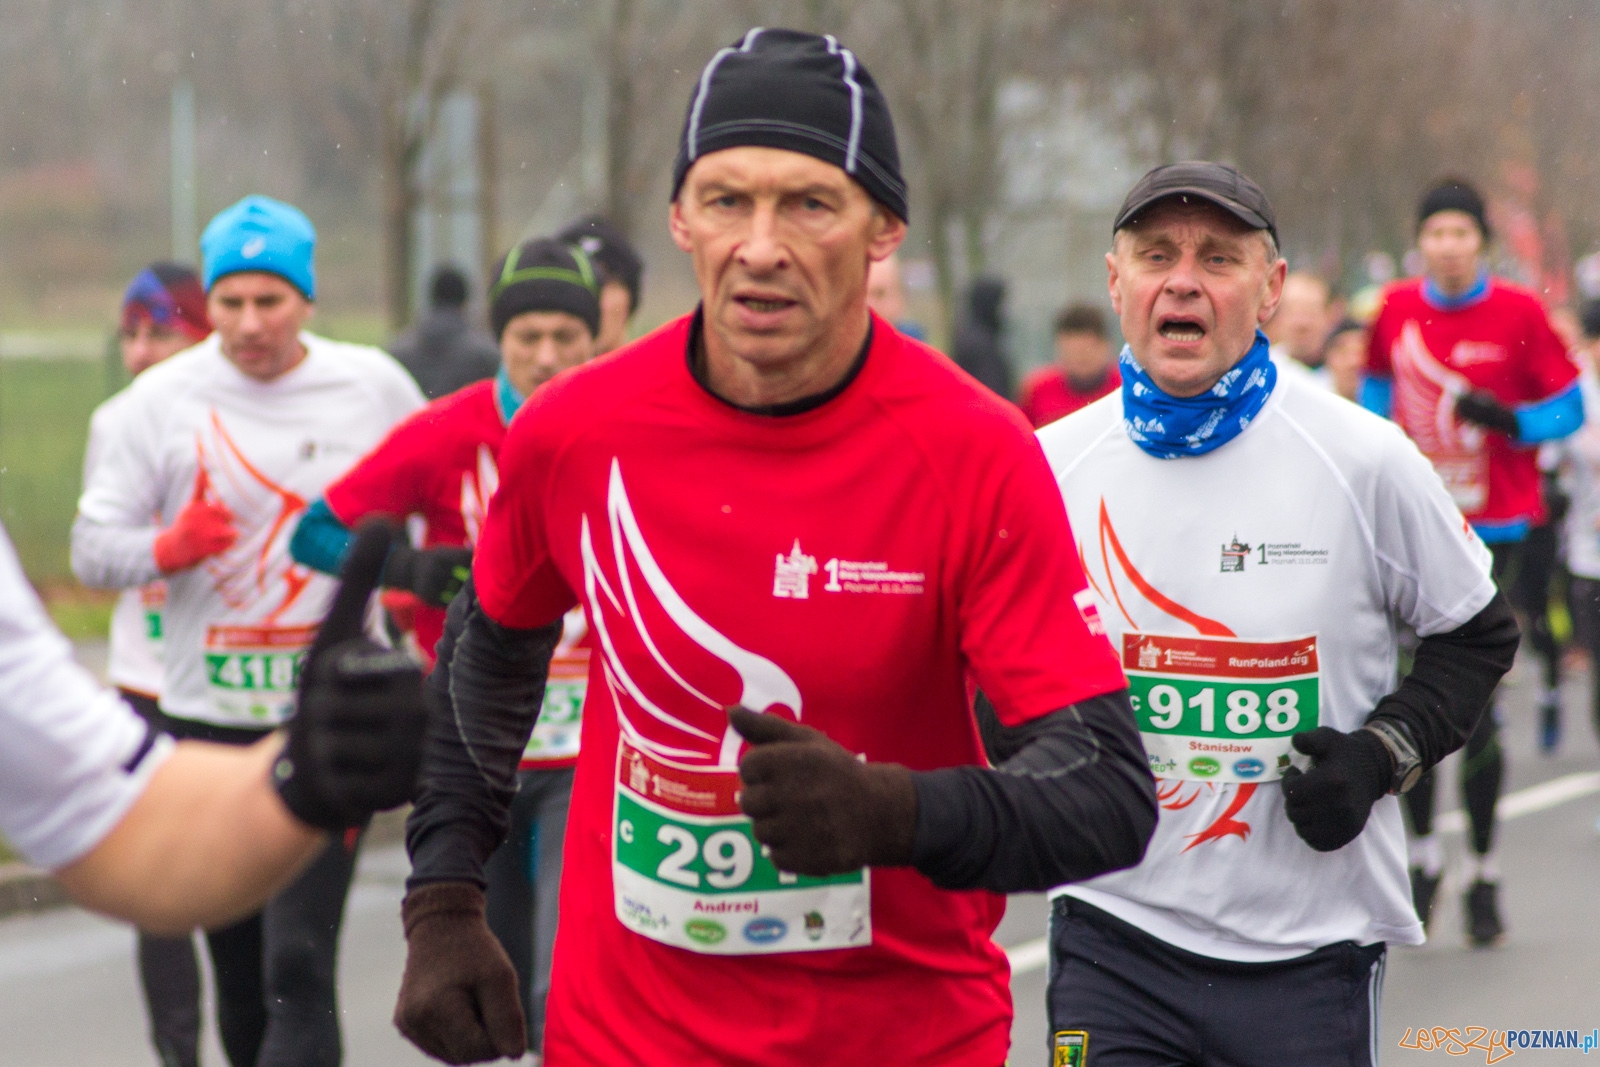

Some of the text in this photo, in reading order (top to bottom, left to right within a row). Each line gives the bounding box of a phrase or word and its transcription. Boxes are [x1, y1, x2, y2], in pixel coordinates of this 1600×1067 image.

[1257, 543, 1268, 565] 1
[1228, 654, 1309, 669] RunPoland.org
[219, 656, 302, 690] 418
[1147, 684, 1300, 735] 9188
[1189, 741, 1253, 753] Stanisław
[693, 899, 759, 914] Andrzej
